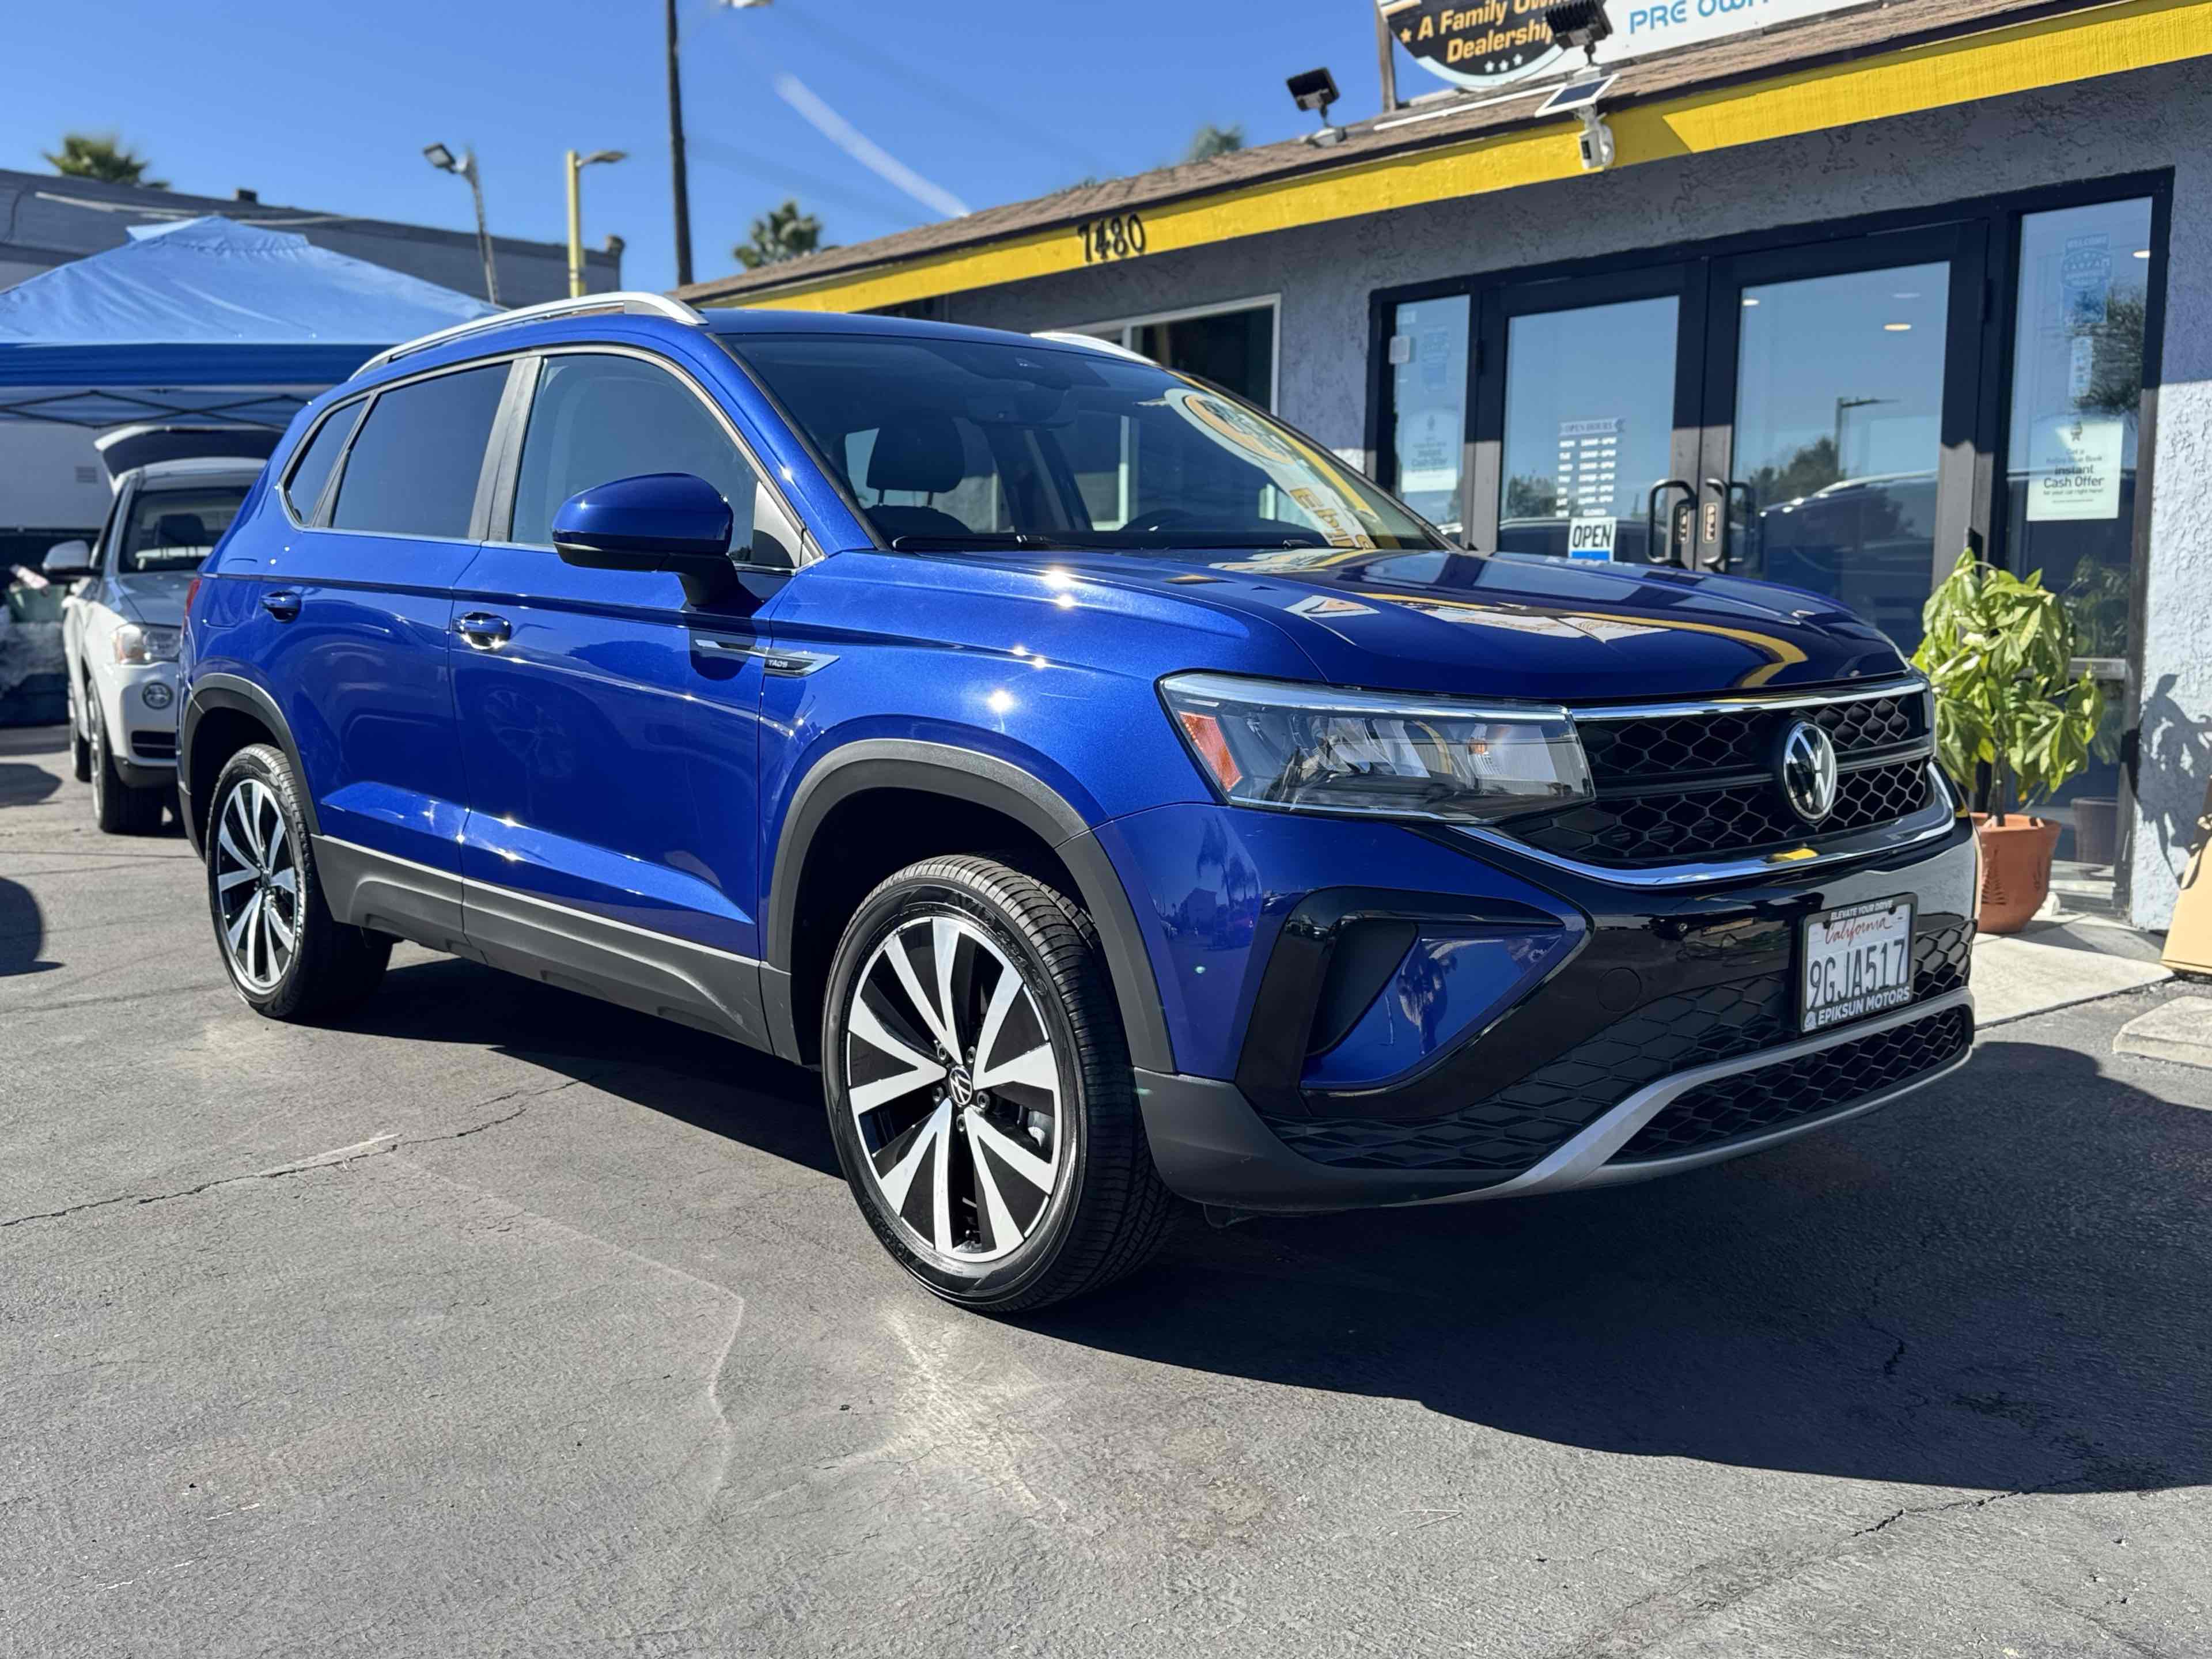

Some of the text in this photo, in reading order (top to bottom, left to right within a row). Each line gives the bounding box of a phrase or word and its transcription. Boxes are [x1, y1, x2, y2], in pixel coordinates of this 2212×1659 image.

[1417, 16, 1433, 40] A
[1440, 0, 1508, 35] Family
[1629, 2, 1687, 34] PRE
[1078, 213, 1146, 262] 7480
[2044, 476, 2104, 488] Cash Offer
[1573, 524, 1612, 547] OPEN
[768, 659, 789, 668] TAOS
[1825, 916, 1893, 946] California
[1809, 939, 1905, 1008] 9GJA517
[1817, 986, 1910, 1025] EPIKSUN MOTORS
